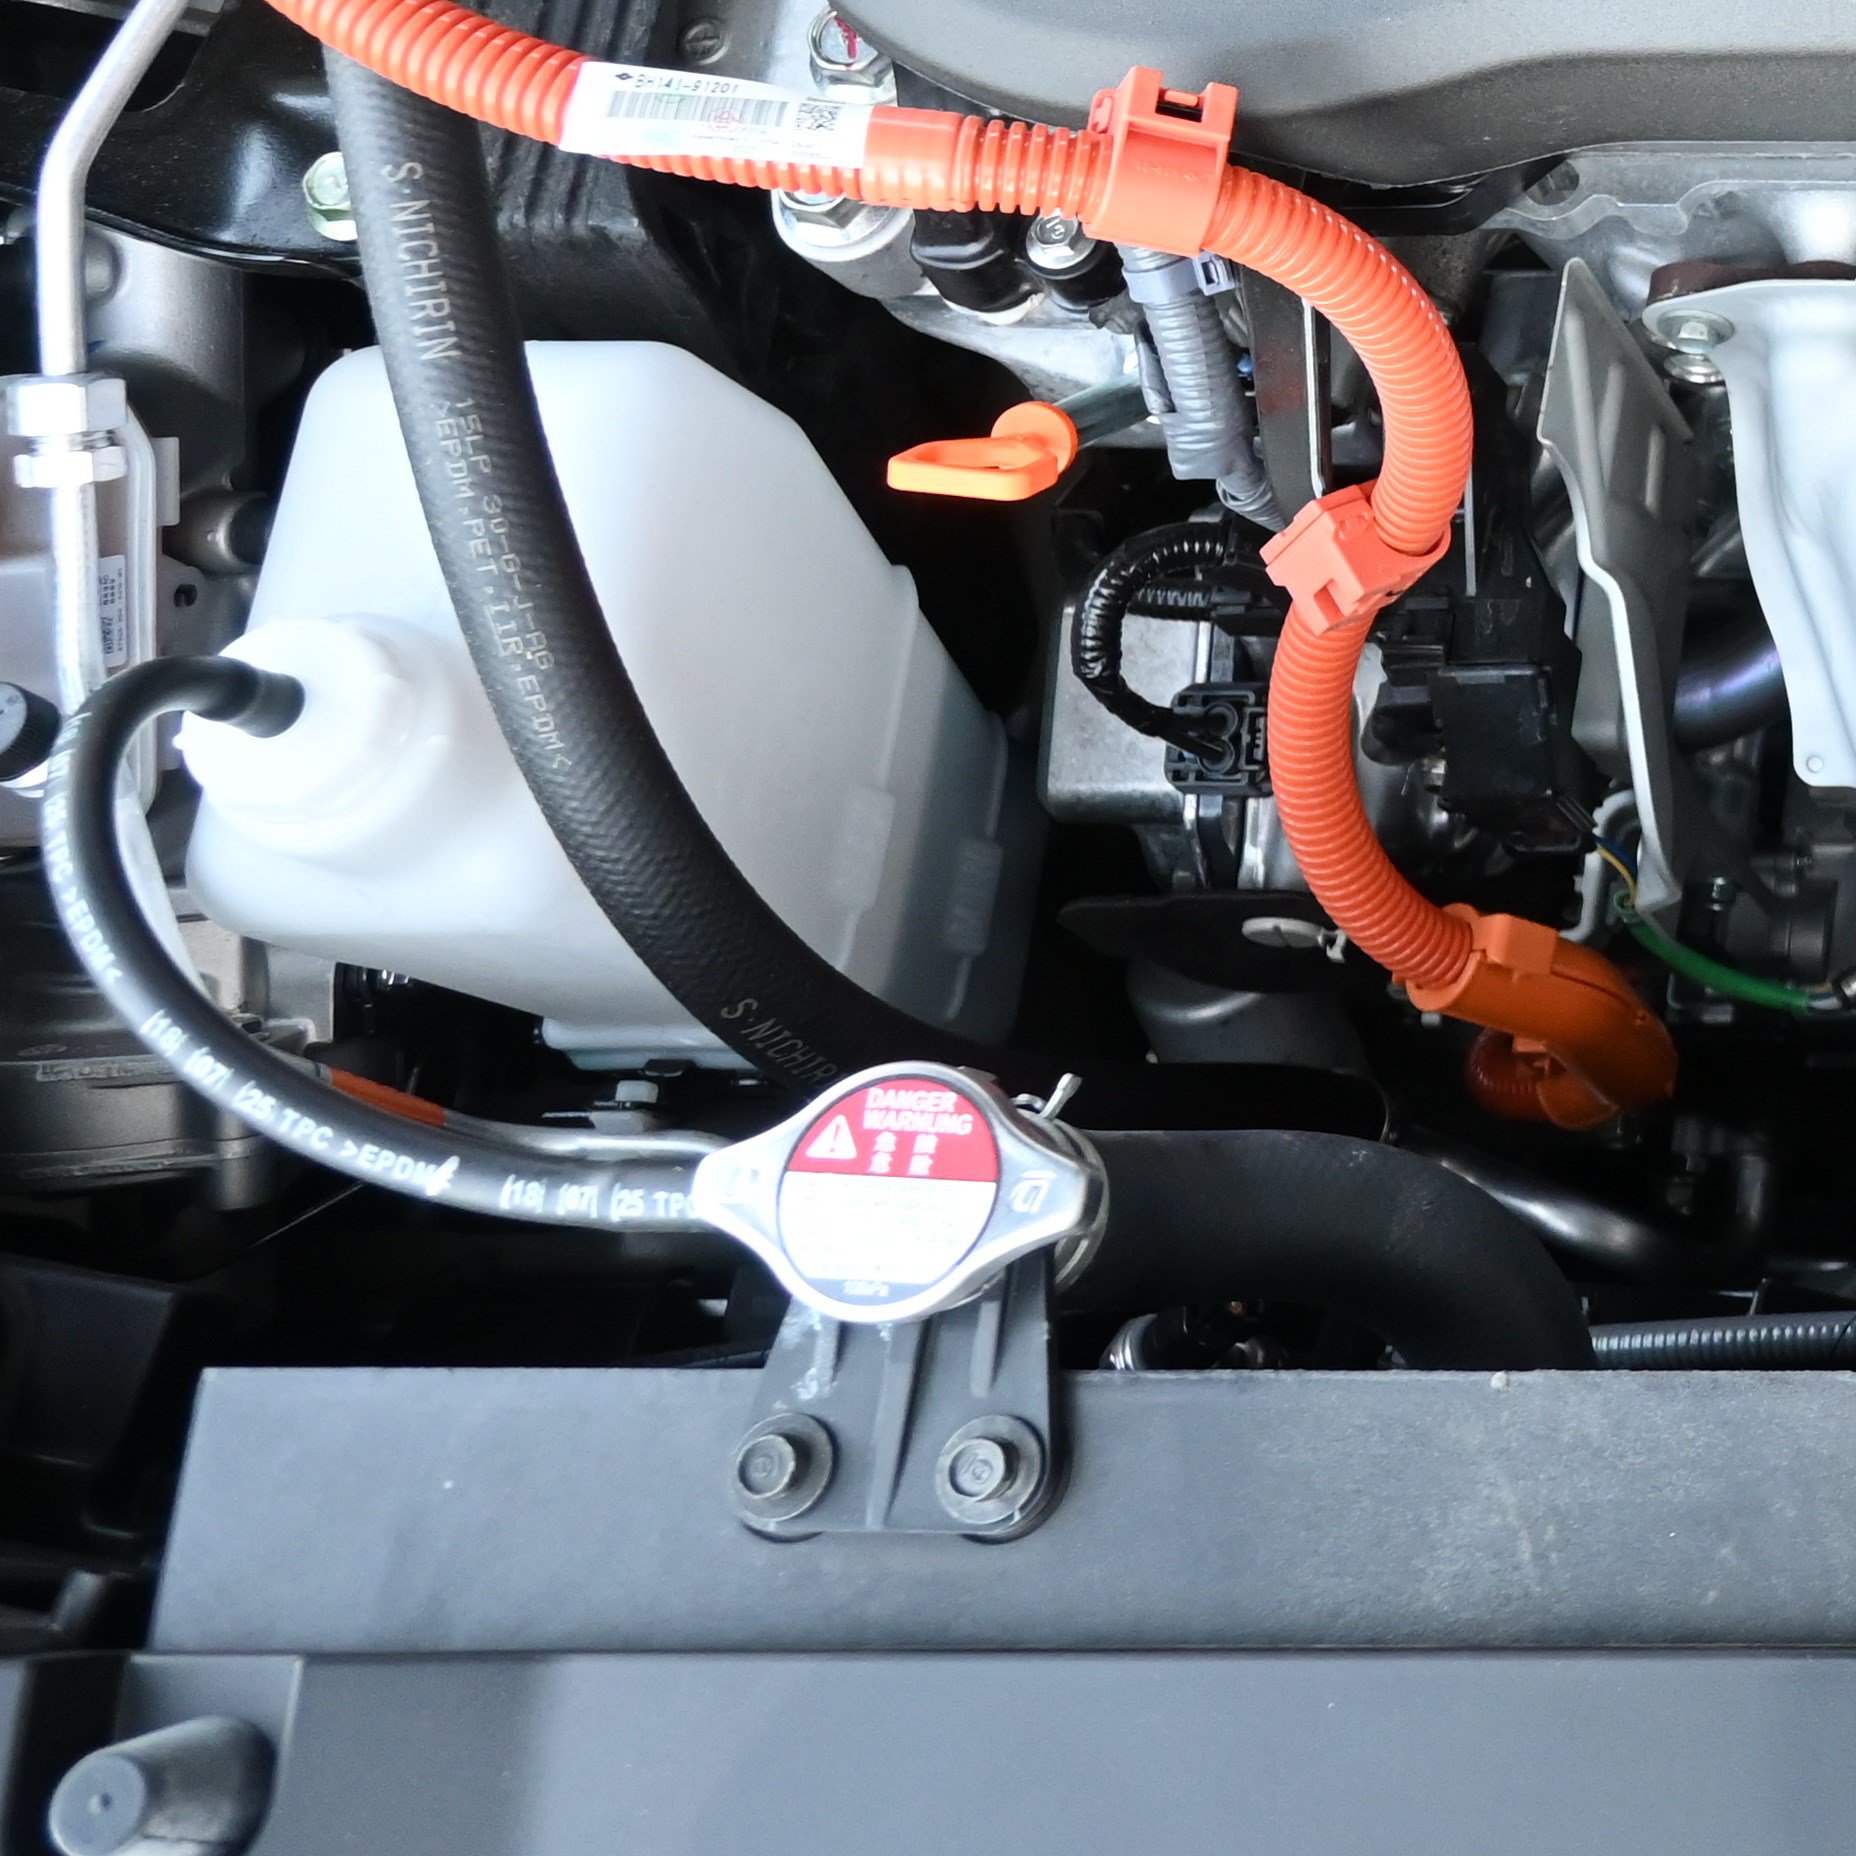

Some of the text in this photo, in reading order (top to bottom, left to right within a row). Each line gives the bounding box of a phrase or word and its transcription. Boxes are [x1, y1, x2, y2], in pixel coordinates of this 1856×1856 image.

[866, 1088, 958, 1112] DANGER
[279, 1106, 330, 1149] TPC
[862, 1109, 973, 1135] WARNUNG
